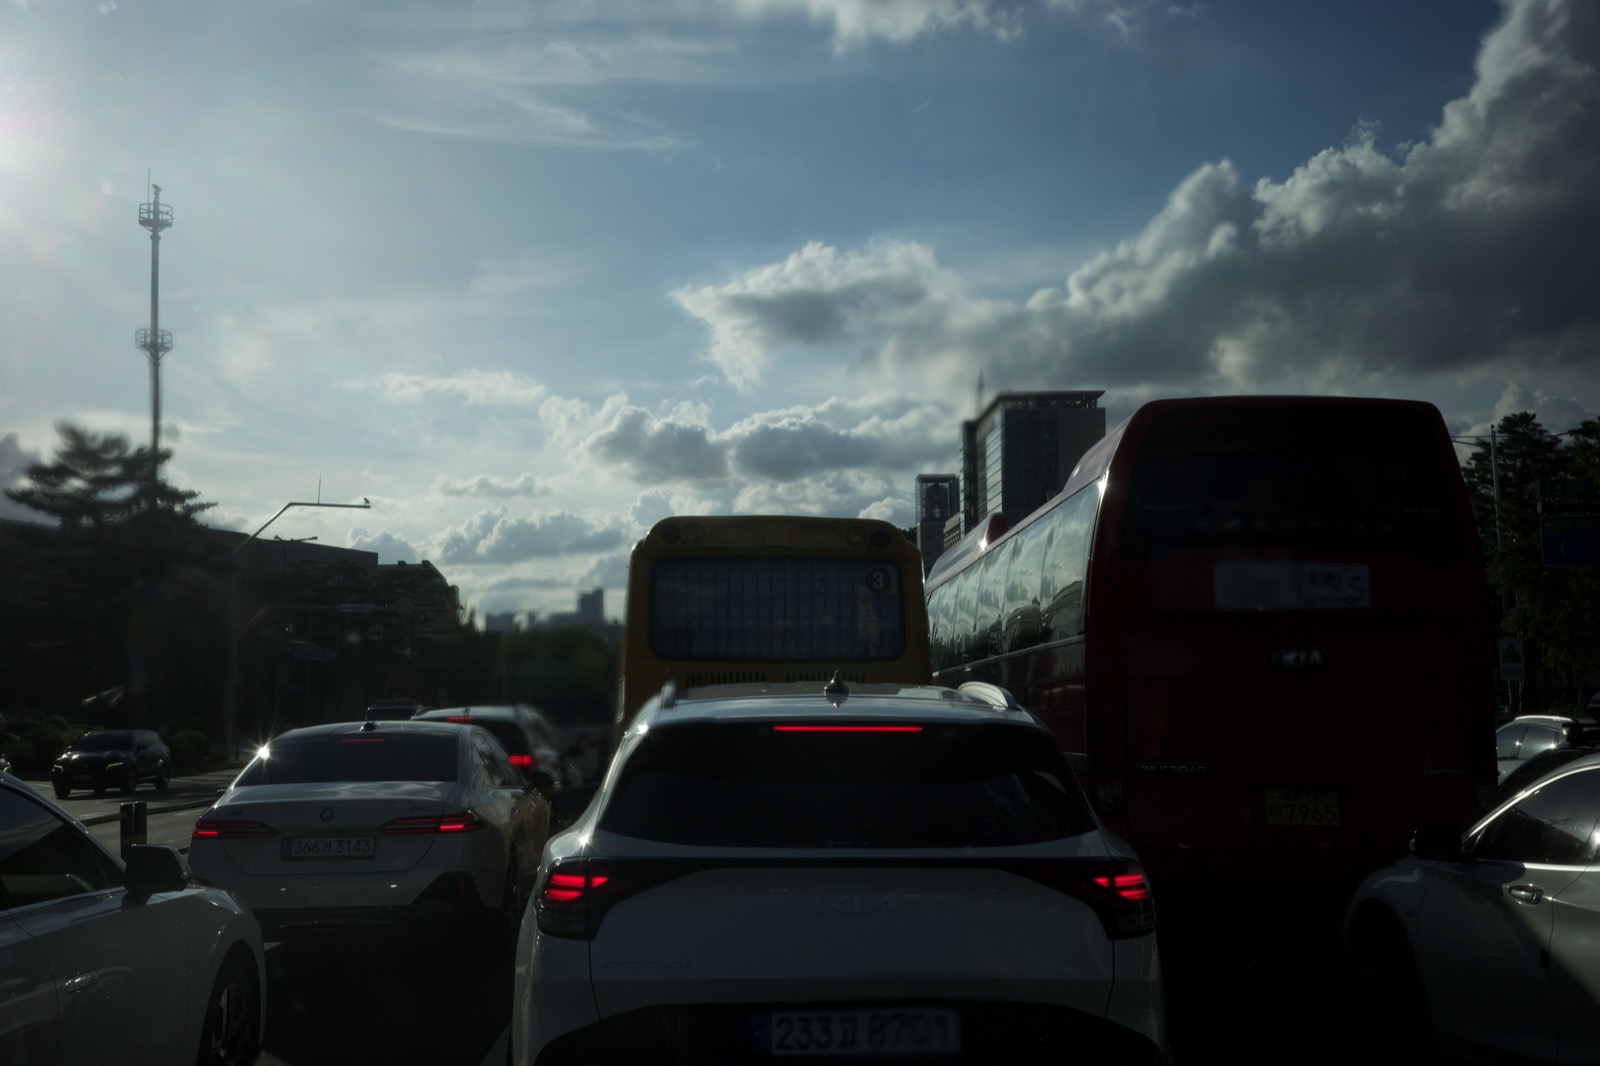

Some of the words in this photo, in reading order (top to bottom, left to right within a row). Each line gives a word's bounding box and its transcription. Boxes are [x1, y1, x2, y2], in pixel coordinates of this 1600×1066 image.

[872, 571, 885, 590] 3
[335, 839, 371, 854] 3143
[811, 894, 898, 915] KIA
